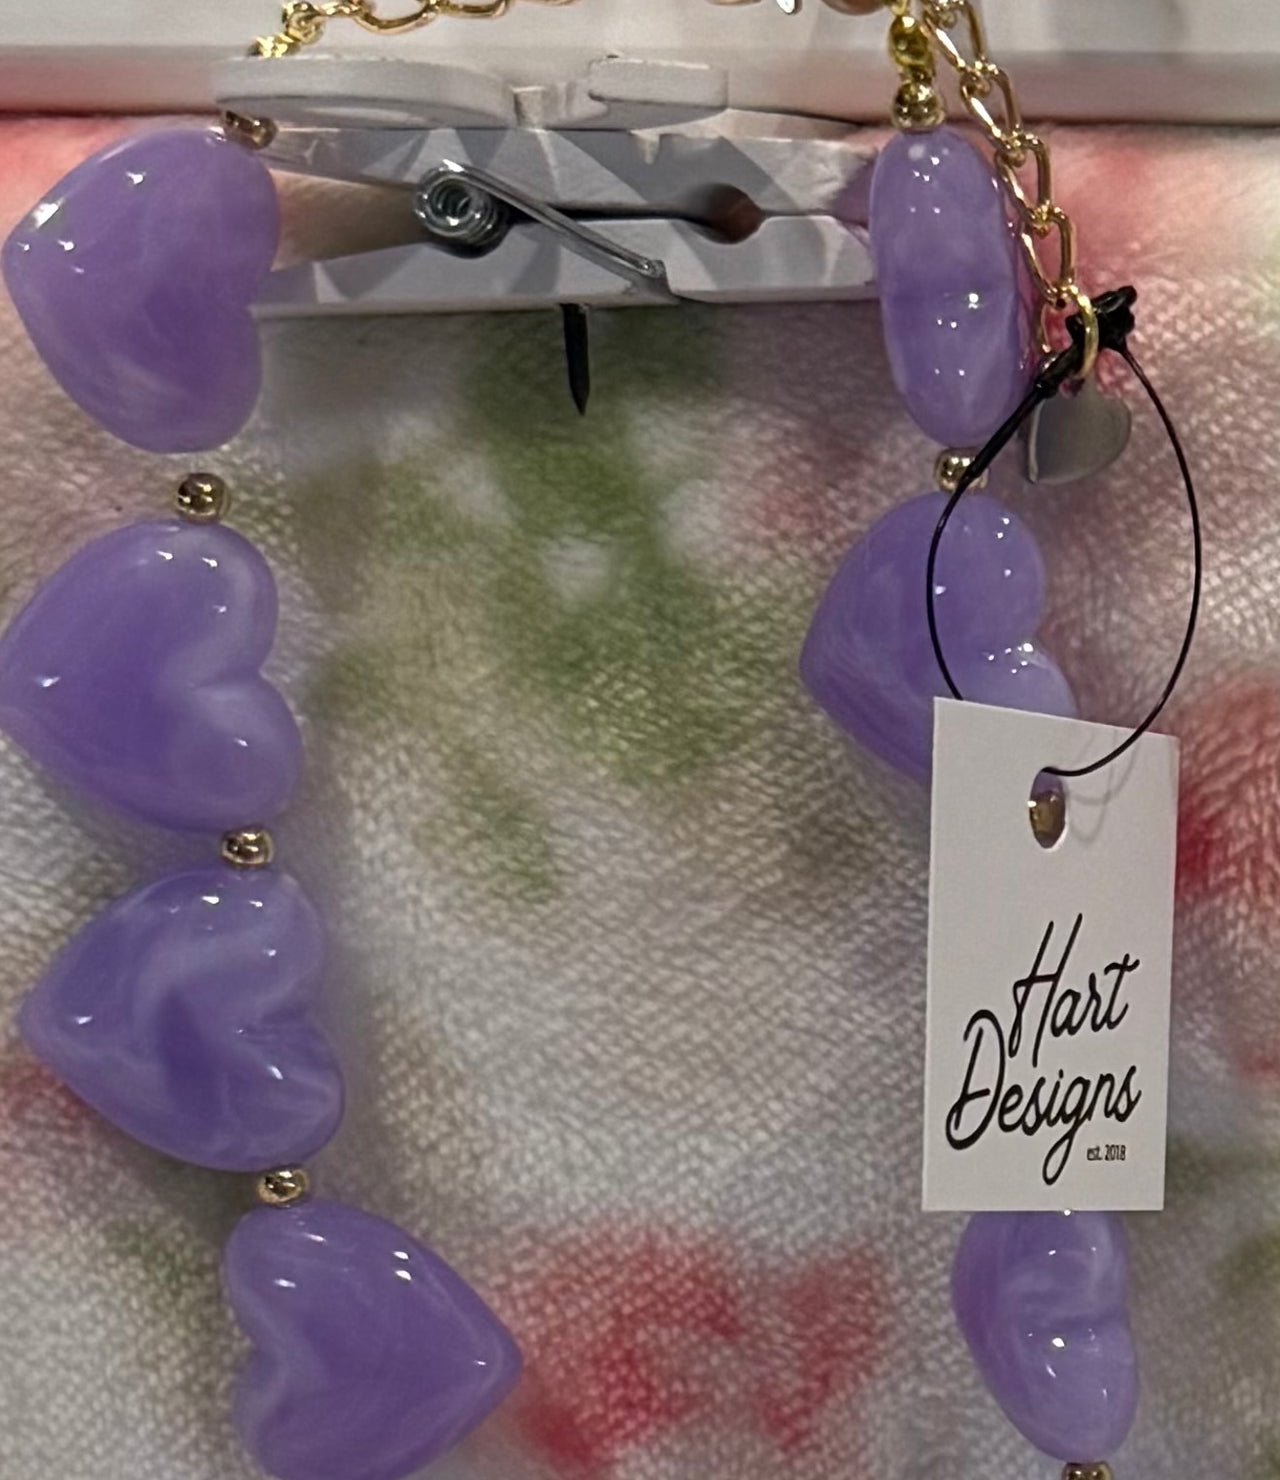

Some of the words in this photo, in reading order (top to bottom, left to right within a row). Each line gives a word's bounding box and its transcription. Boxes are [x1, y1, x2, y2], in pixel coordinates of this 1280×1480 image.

[1008, 913, 1140, 1067] Hart
[946, 1009, 1142, 1185] Designs
[1105, 1144, 1126, 1161] 2018
